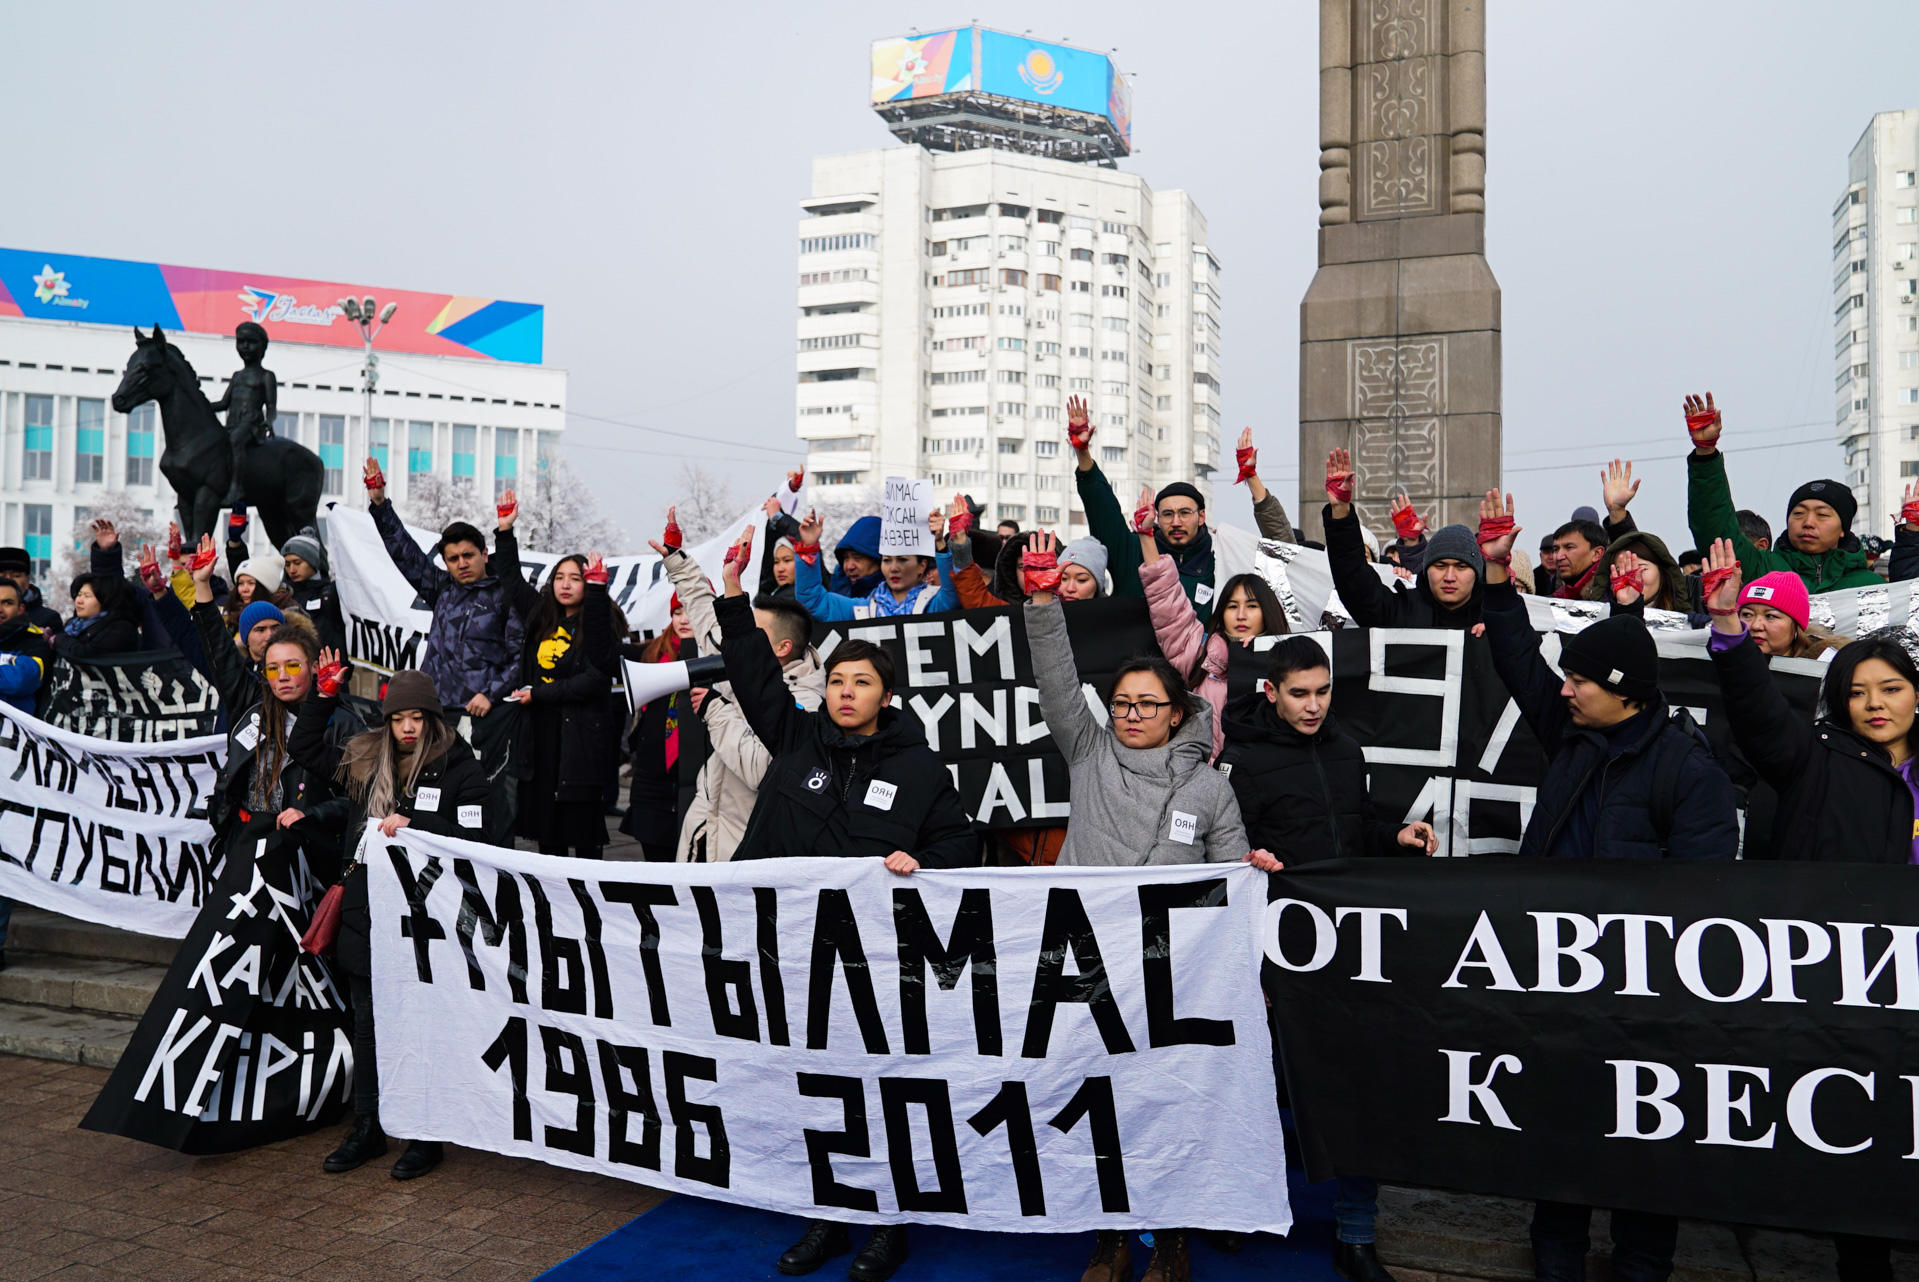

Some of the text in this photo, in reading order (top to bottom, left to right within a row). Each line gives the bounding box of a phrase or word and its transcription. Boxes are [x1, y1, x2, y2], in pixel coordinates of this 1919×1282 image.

[1262, 897, 1919, 1011] ОТ АВТОРИ
[481, 1015, 1131, 1217] 1986 2011
[1438, 1049, 1523, 1132] К
